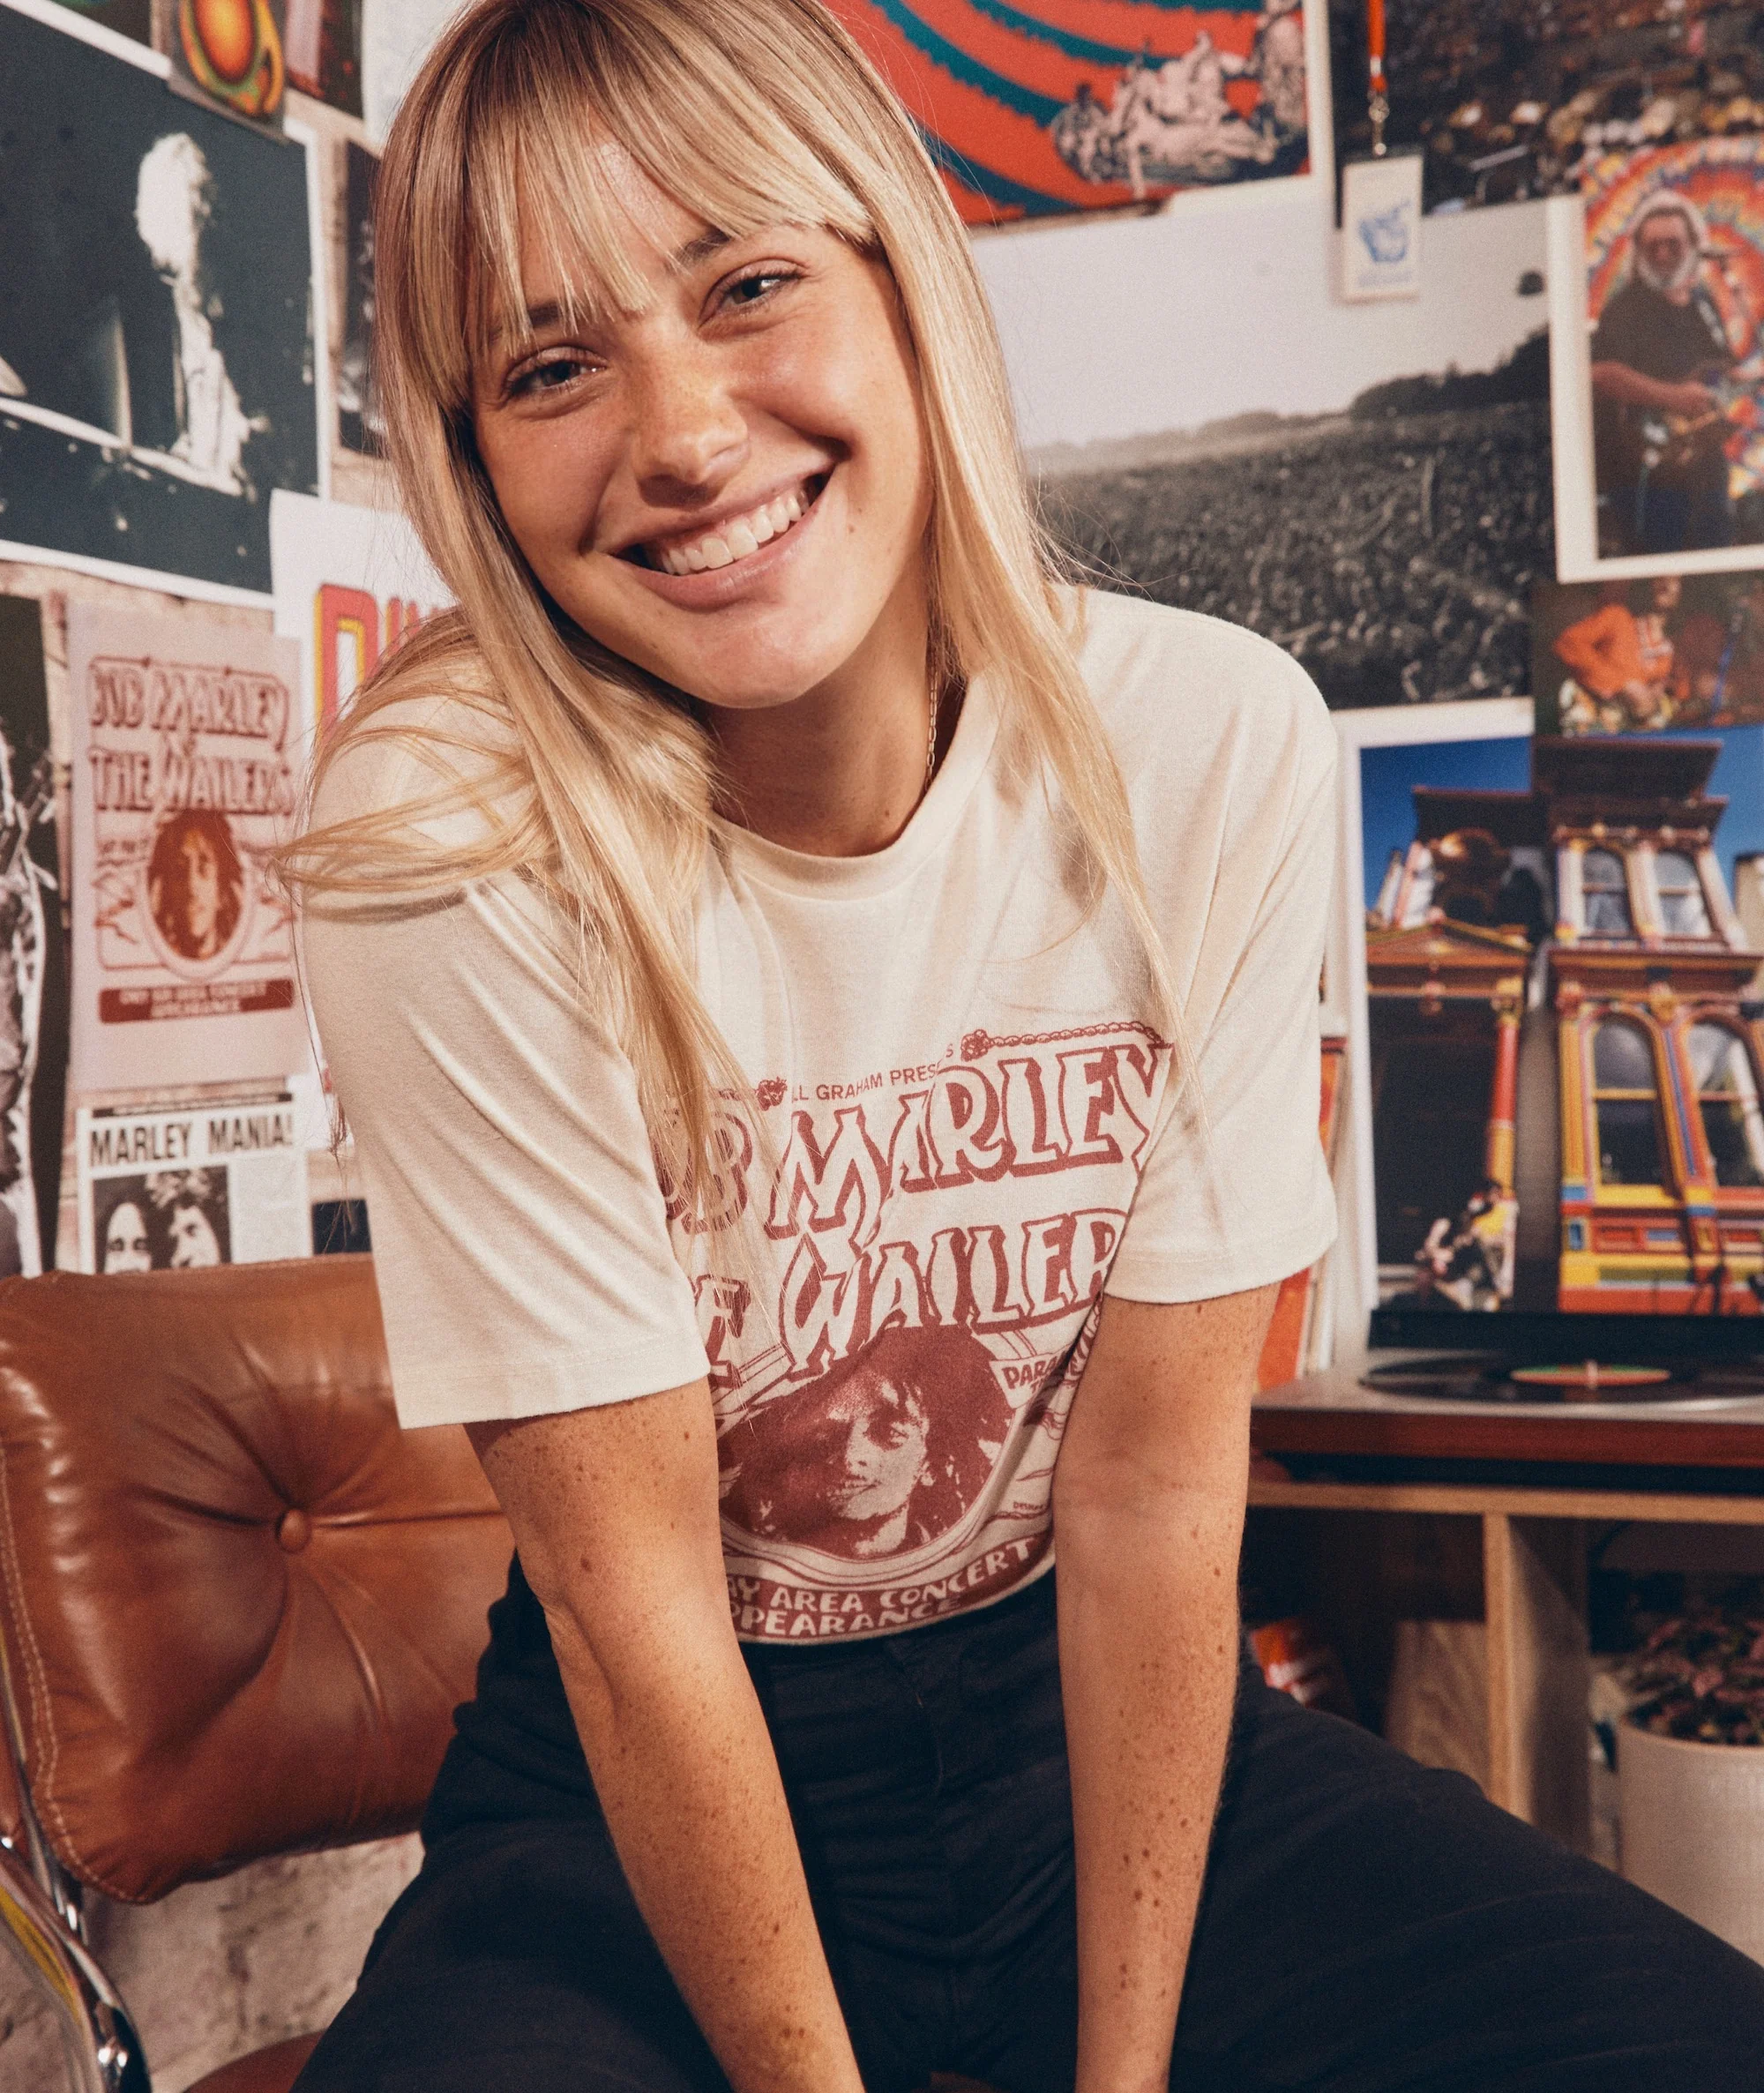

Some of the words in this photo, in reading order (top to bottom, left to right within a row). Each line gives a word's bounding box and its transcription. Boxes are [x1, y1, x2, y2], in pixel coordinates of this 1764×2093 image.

[816, 1072, 884, 1102] GRAHAM
[90, 1121, 192, 1167] MARLEY
[208, 1113, 293, 1155] MANIA!
[761, 1043, 1175, 1248] MARLEY
[778, 1207, 1127, 1383] WAILER
[770, 1586, 864, 1613] AREA
[878, 1536, 1035, 1610] CONCERT
